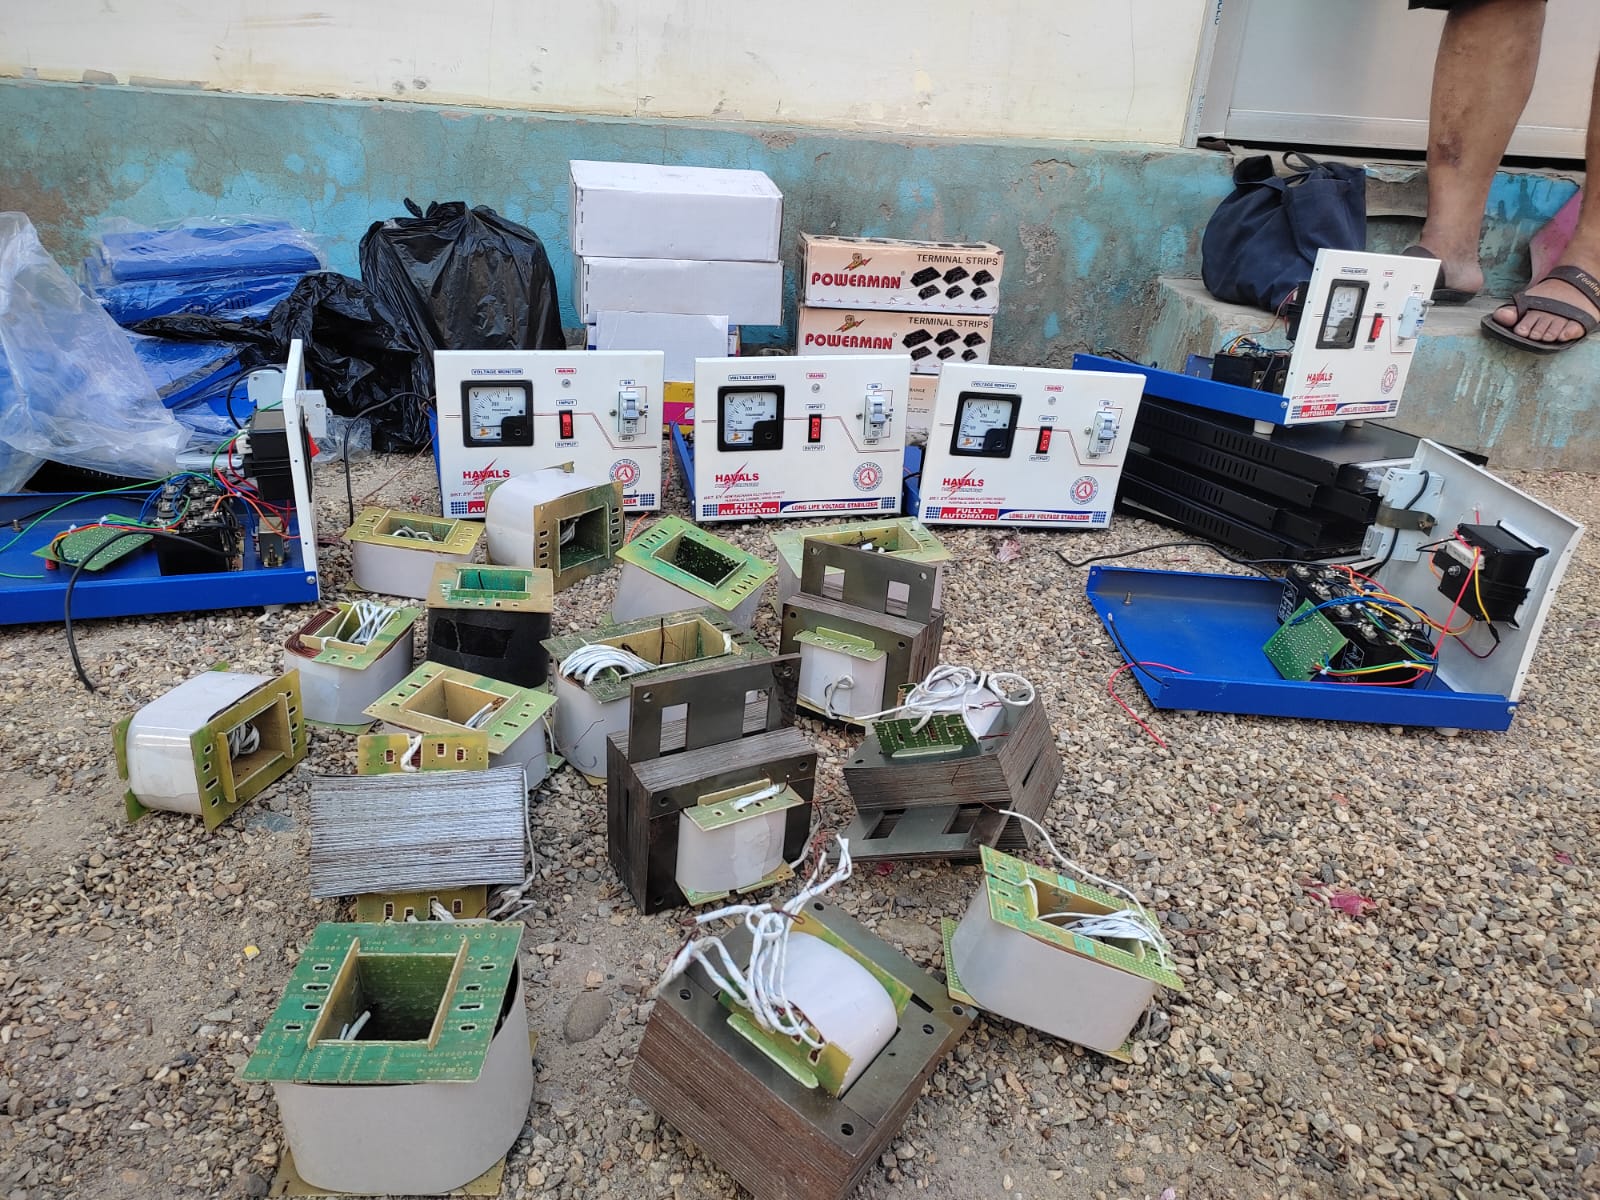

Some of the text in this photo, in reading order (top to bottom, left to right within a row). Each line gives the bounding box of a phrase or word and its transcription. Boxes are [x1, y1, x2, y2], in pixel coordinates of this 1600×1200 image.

[917, 254, 999, 266] TERMINAL STRIPS
[811, 272, 901, 289] POWERMAN
[909, 316, 989, 329] TERMINAL STRIPS
[805, 333, 893, 350] POWERMAN
[1306, 373, 1333, 382] HAVALS
[462, 469, 511, 479] HAVALS
[715, 473, 759, 482] HAVALS
[942, 478, 985, 487] HAVALS
[720, 507, 777, 515] AUTOMATIC
